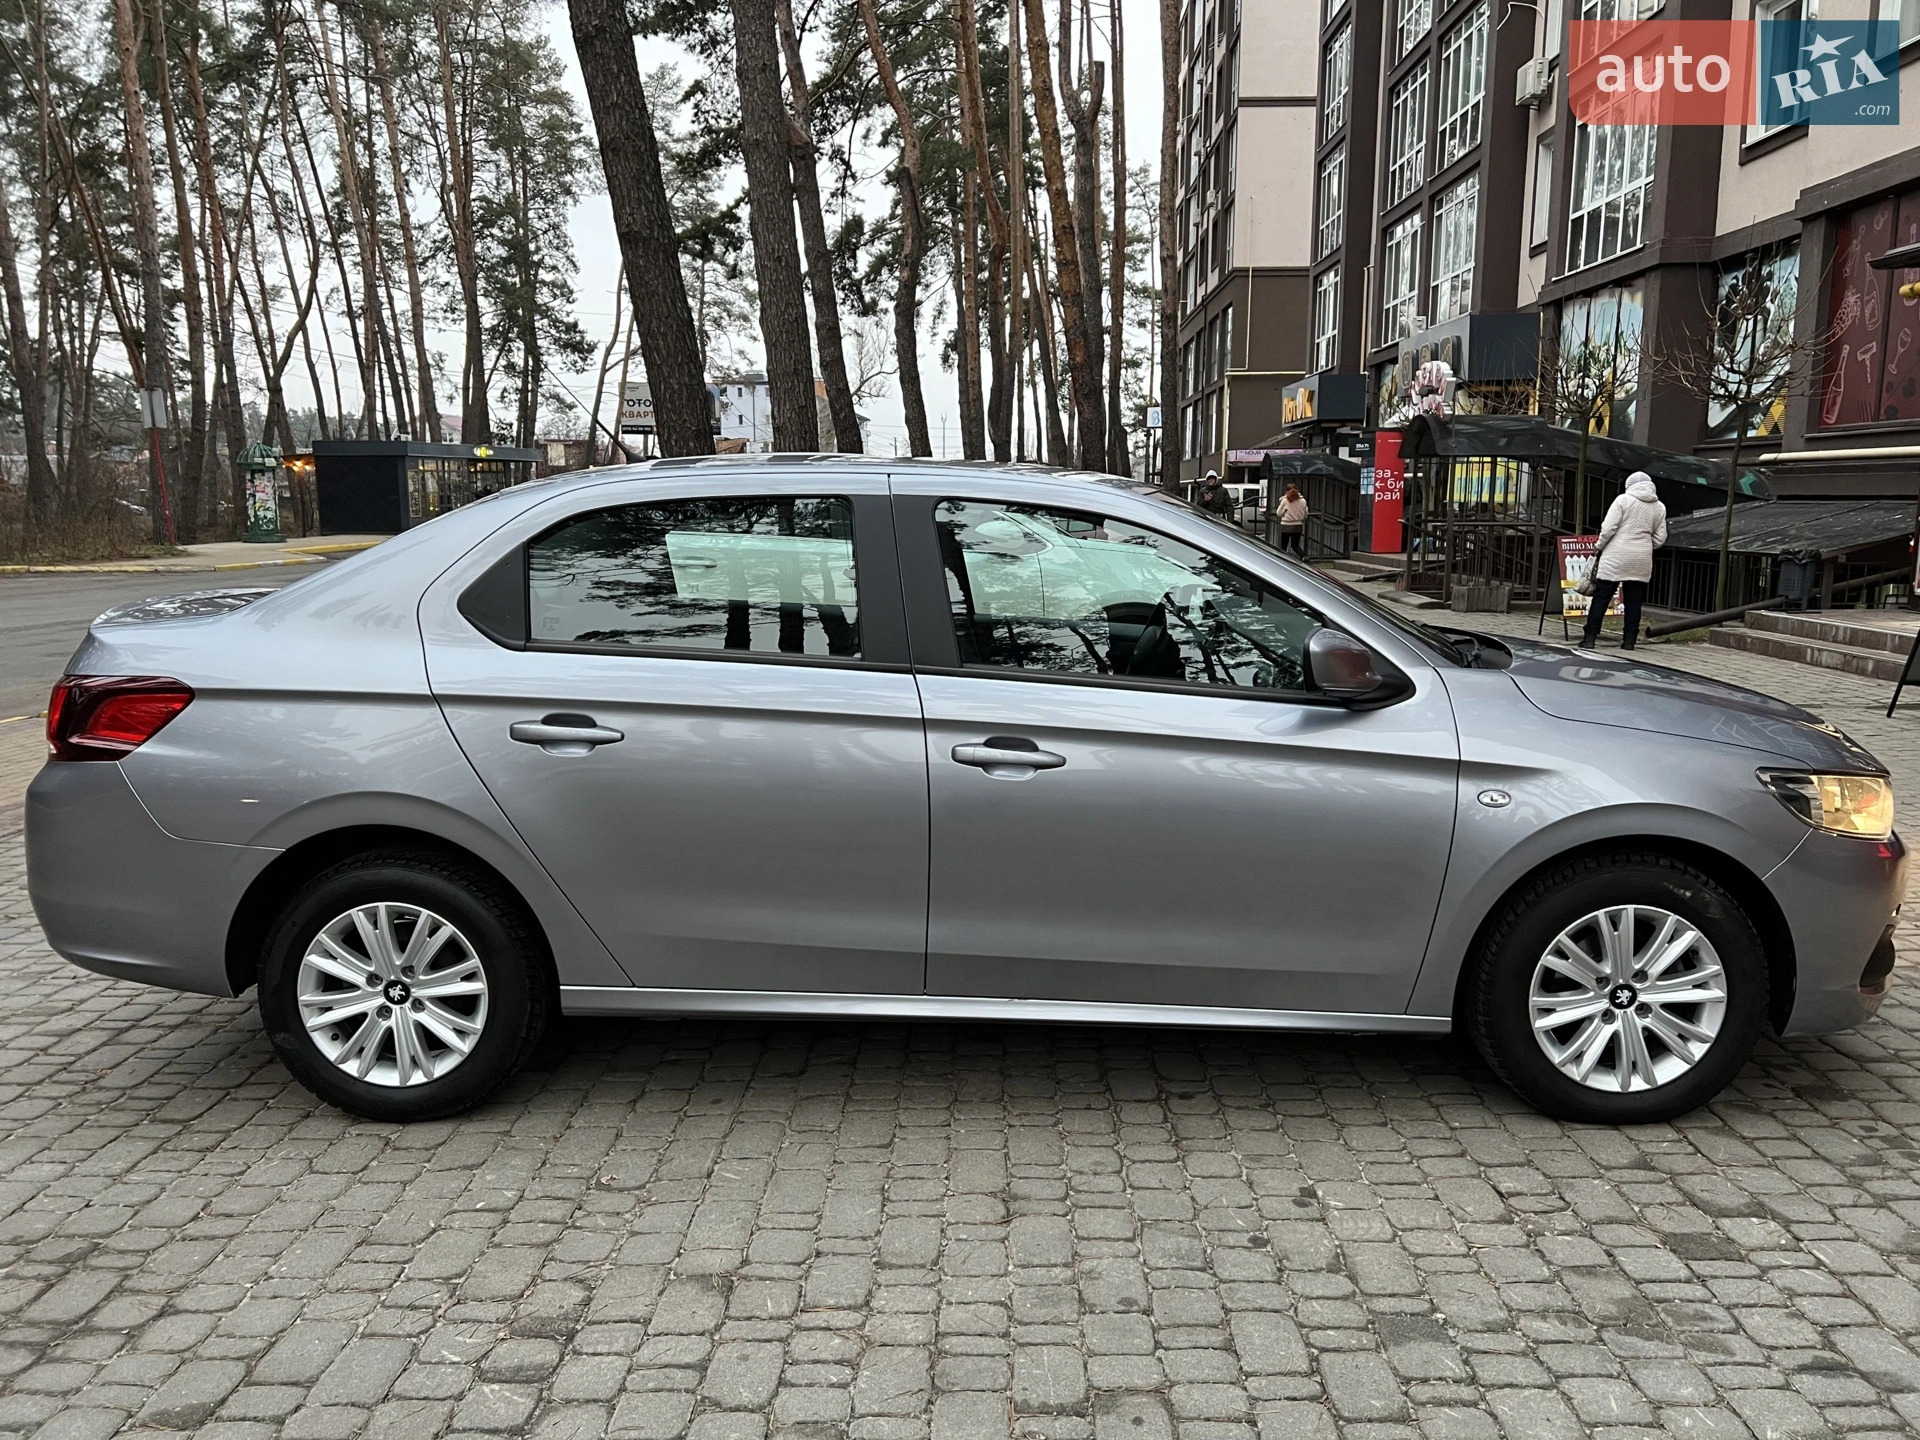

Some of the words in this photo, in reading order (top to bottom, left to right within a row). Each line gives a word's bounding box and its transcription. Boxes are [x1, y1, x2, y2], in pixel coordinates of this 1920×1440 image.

[624, 398, 652, 407] ОТО
[1387, 478, 1404, 489] би
[1375, 488, 1401, 502] рай
